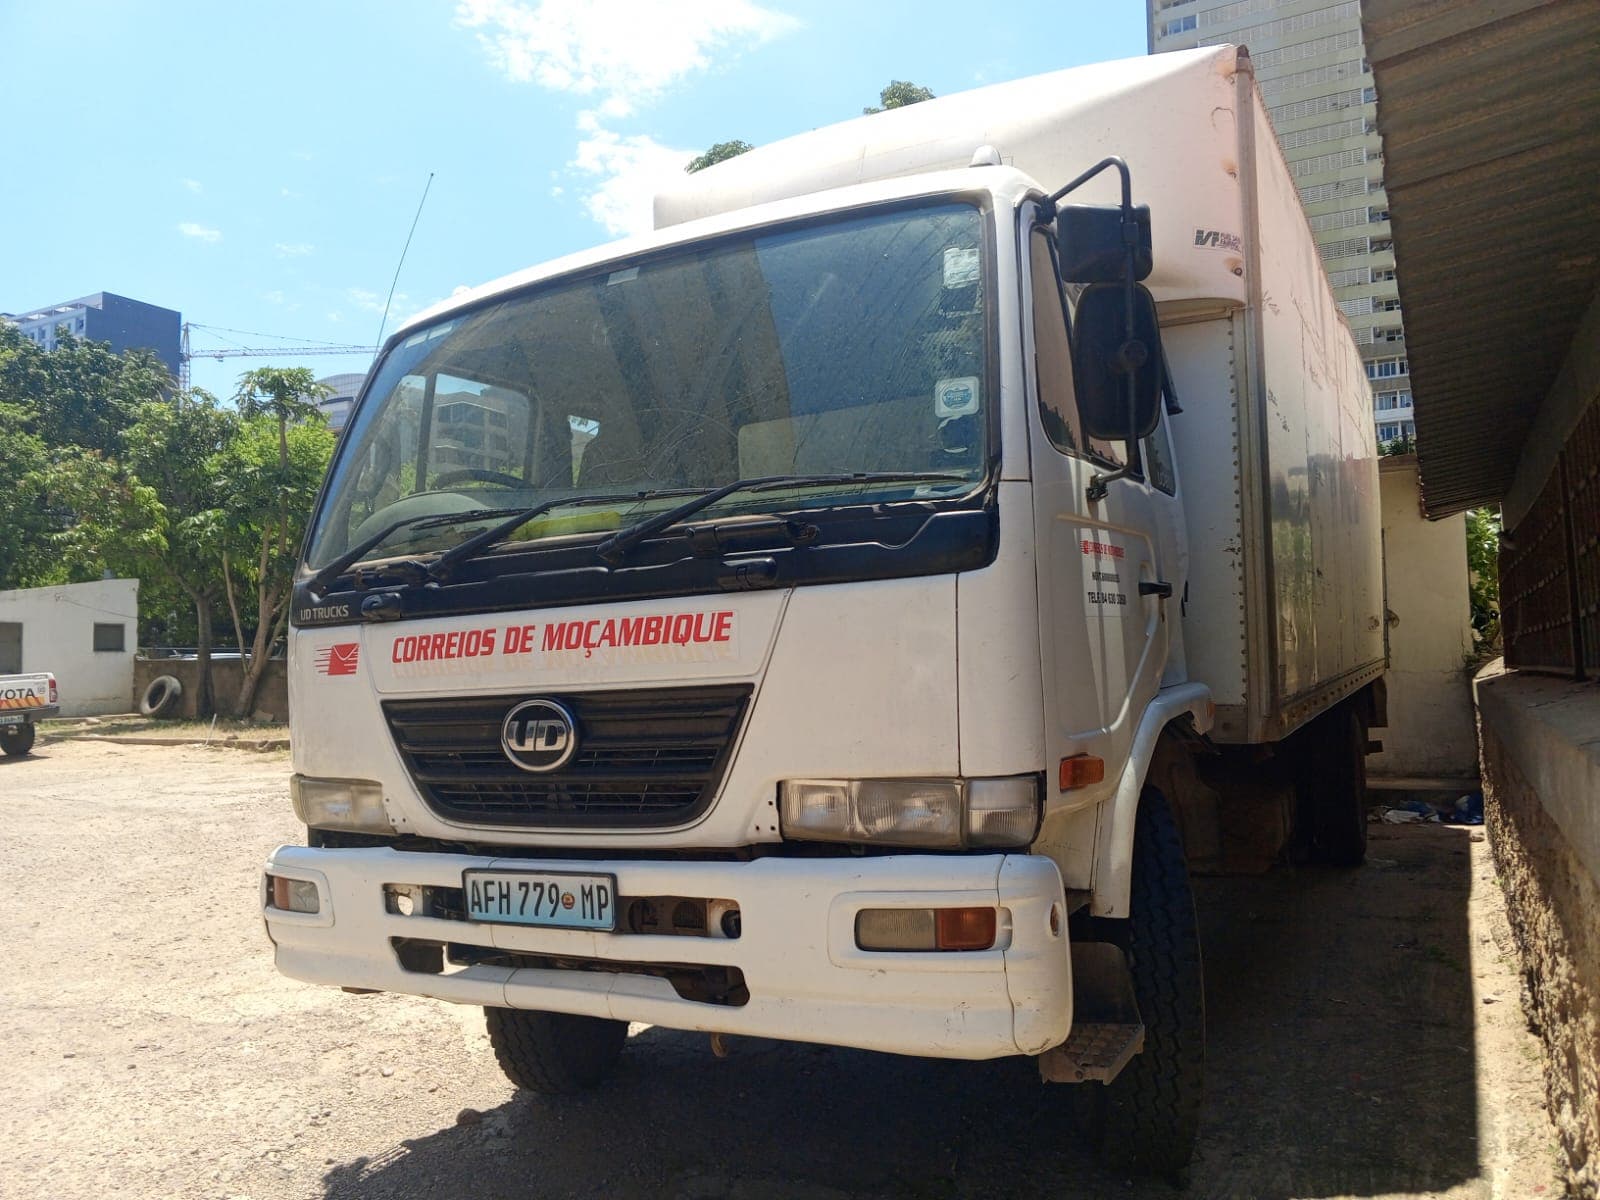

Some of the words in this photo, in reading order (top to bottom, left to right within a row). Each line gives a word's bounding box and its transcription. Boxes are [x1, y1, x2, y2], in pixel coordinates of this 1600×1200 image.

[300, 608, 312, 620] UD
[312, 604, 349, 619] TRUCKS
[392, 628, 497, 664] CORREIOS
[503, 625, 535, 655] DE
[541, 612, 733, 658] MOÇAMBIQUE
[507, 720, 566, 751] UD
[471, 880, 510, 915] AFH
[518, 881, 560, 918] 779
[580, 883, 609, 921] MP
